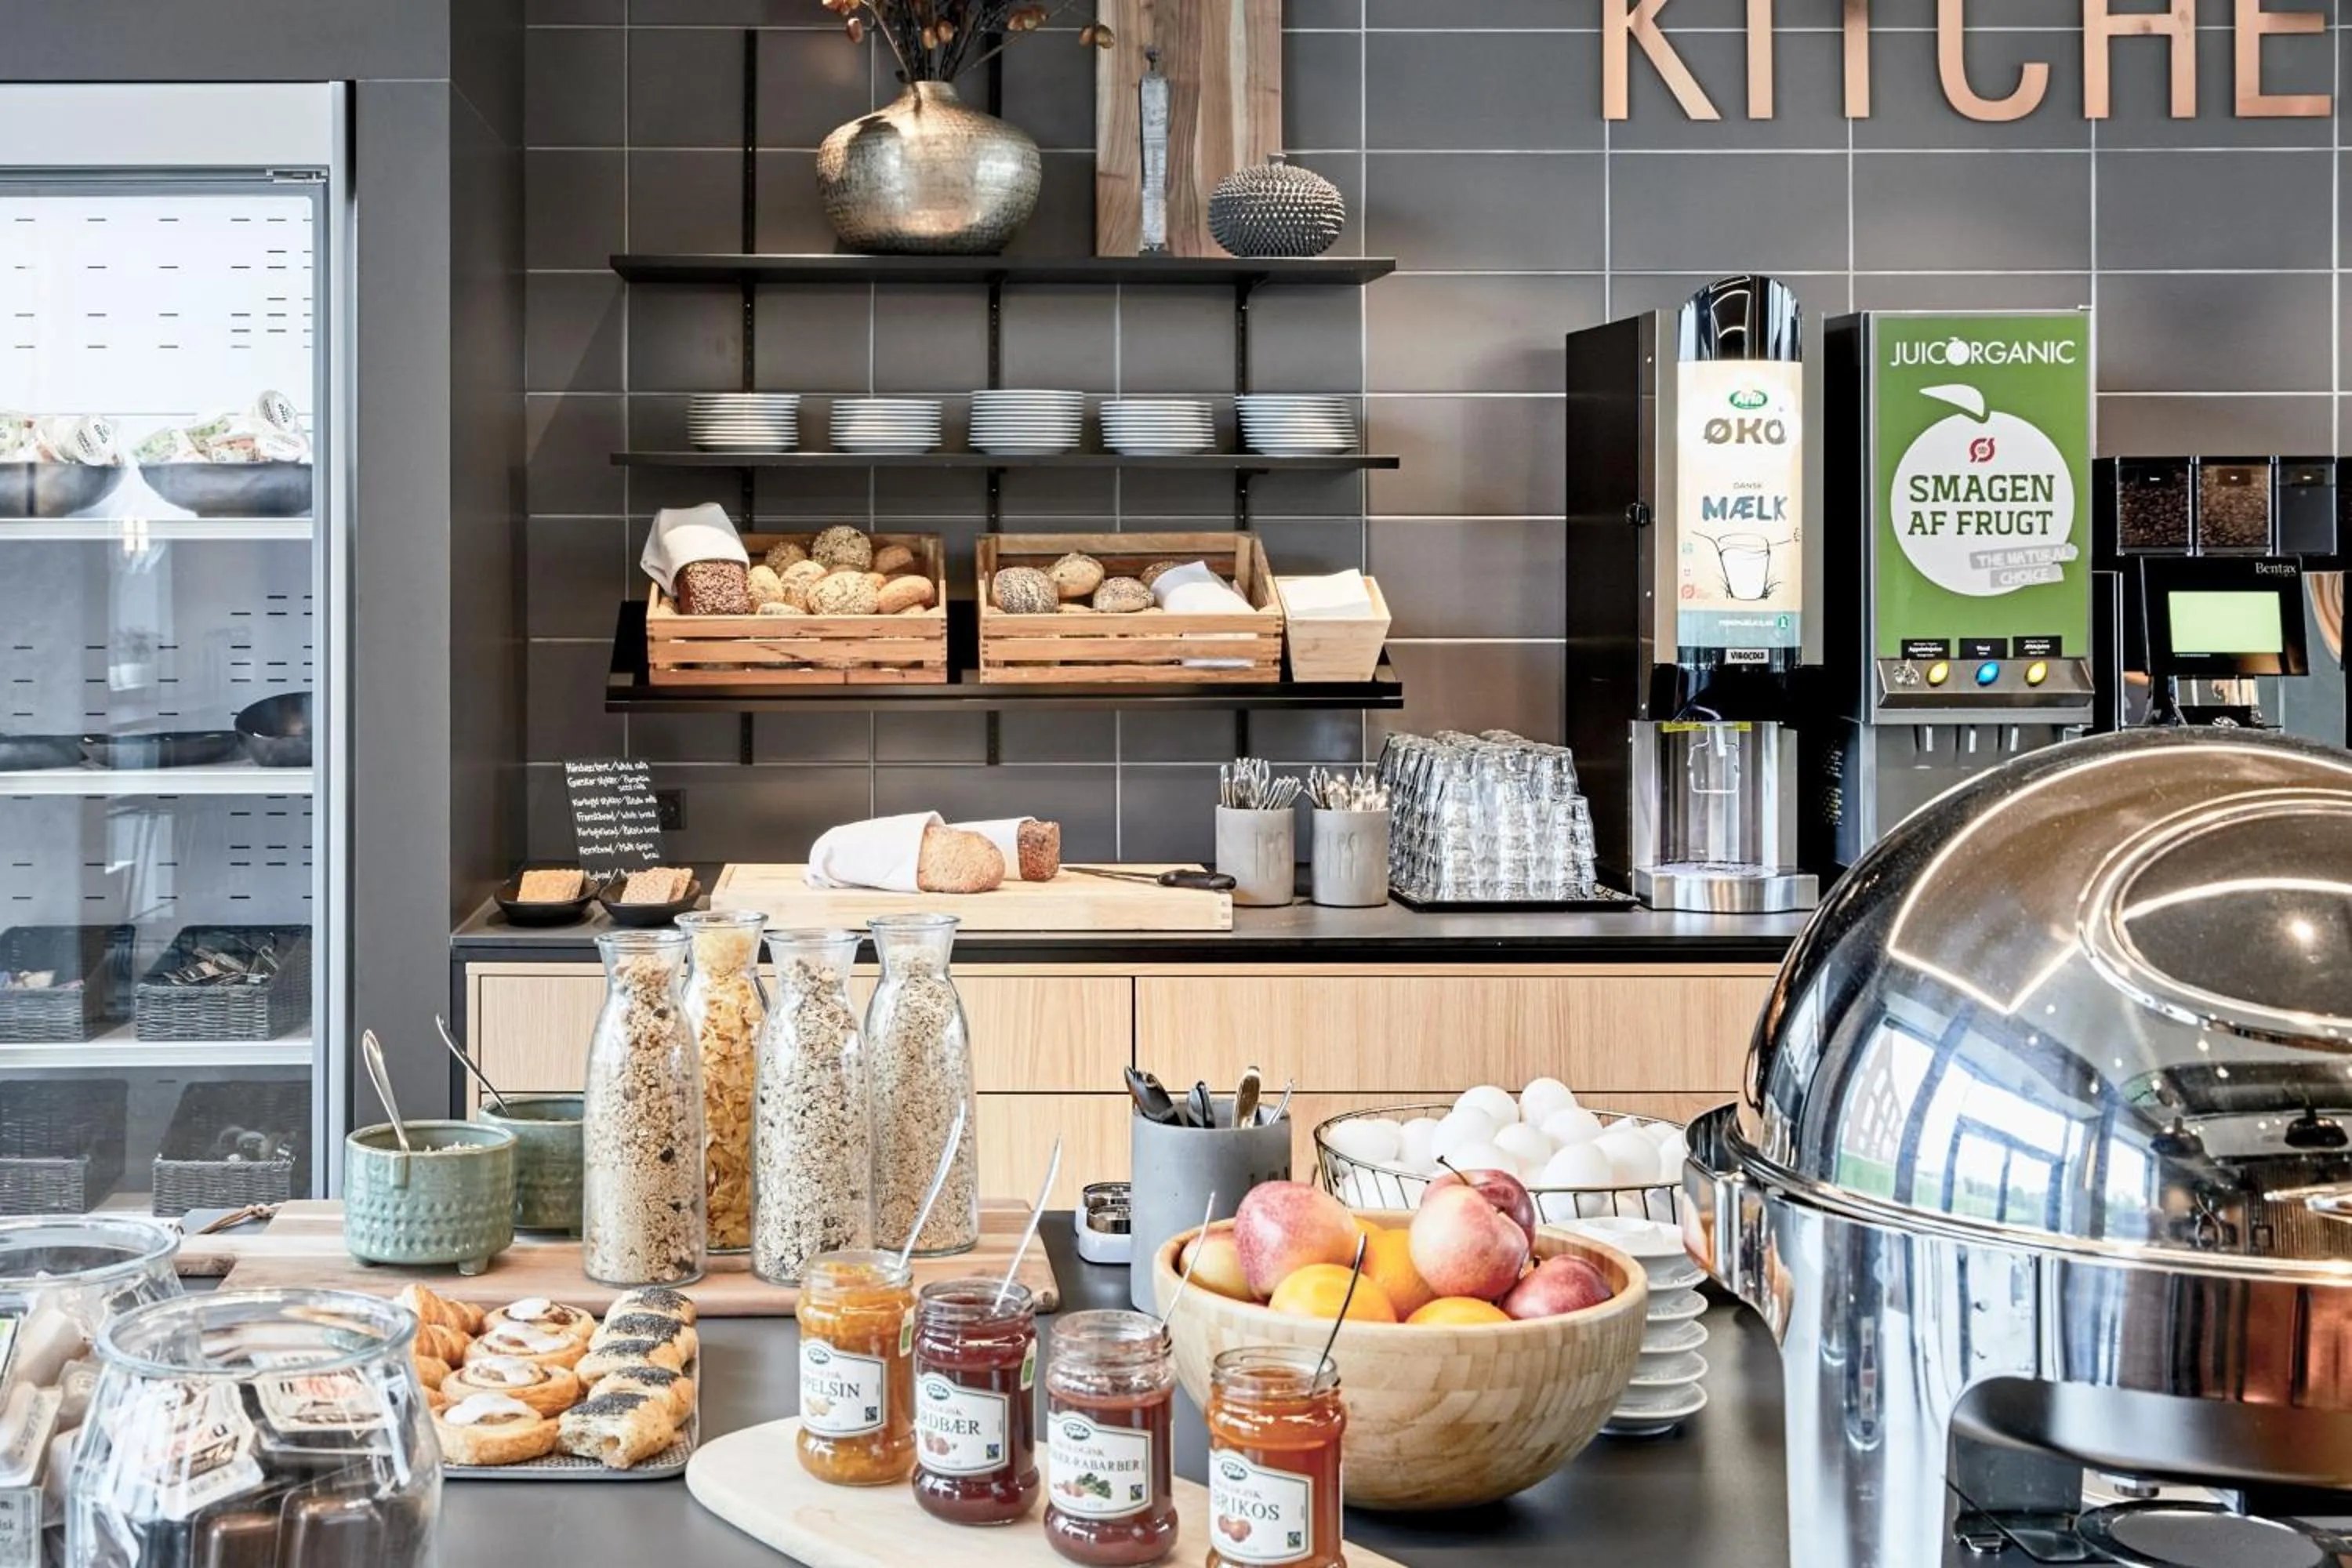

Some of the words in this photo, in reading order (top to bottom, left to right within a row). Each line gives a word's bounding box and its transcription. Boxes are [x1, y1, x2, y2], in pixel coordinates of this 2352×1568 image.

[1704, 417, 1788, 445] ØKO
[1909, 474, 2055, 503] SMAGEN
[1702, 495, 1788, 521] MÆLK
[1907, 510, 1947, 535] AF
[1956, 510, 2053, 535] FRUGT
[1976, 554, 2005, 568] THE
[2000, 568, 2049, 586] CHOICE
